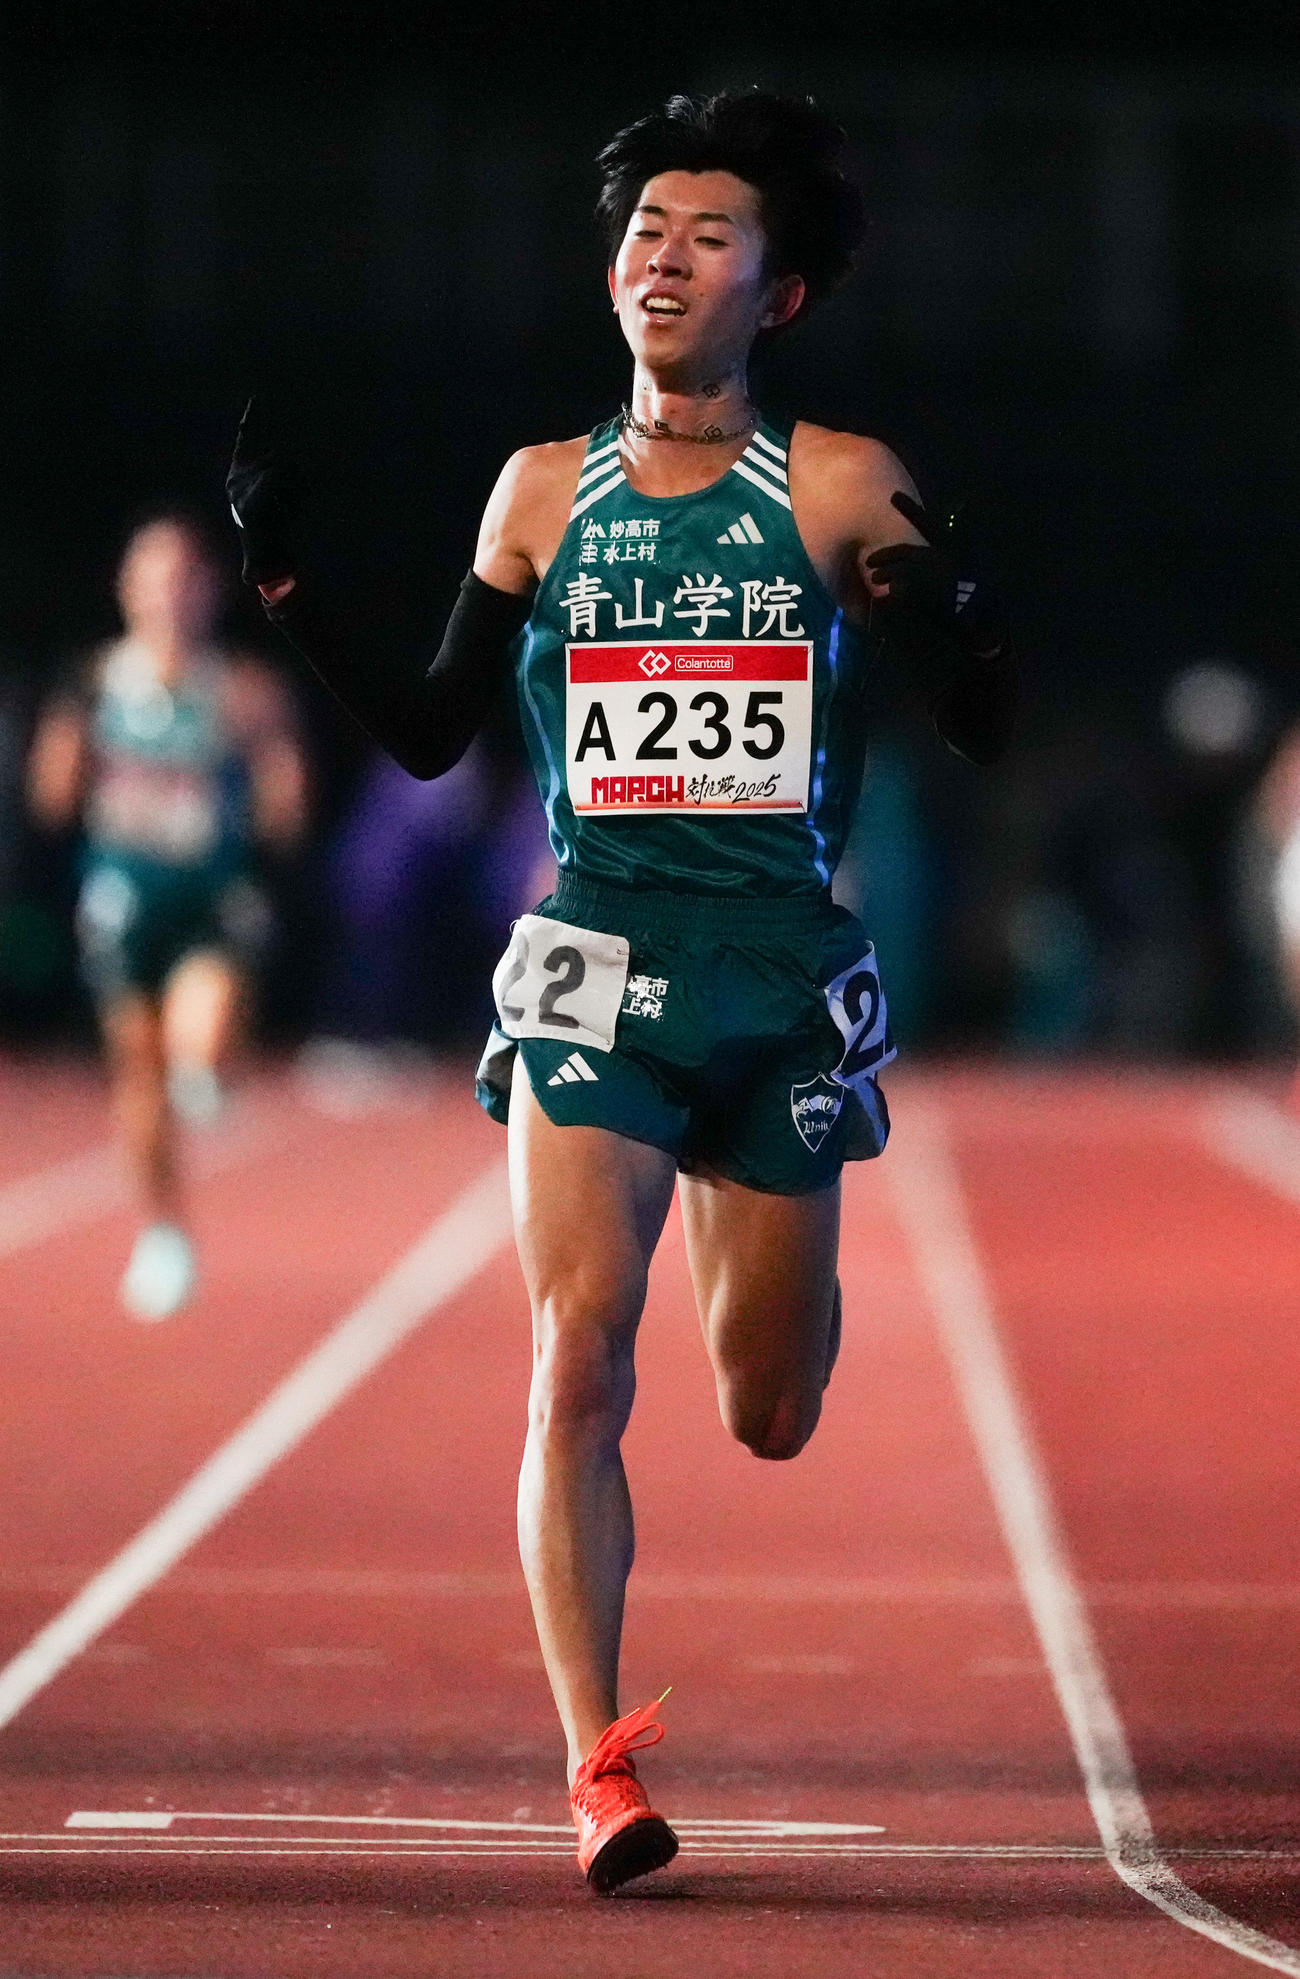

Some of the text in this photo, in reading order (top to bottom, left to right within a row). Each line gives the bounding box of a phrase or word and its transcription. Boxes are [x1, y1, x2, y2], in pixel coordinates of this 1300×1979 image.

[609, 518, 661, 539] 妙高市
[603, 541, 657, 564] 水上村
[558, 572, 806, 638] 青山学院
[677, 658, 731, 670] Colantotte
[574, 691, 785, 762] A 235
[591, 775, 684, 803] MARCH
[732, 773, 782, 803] 2025
